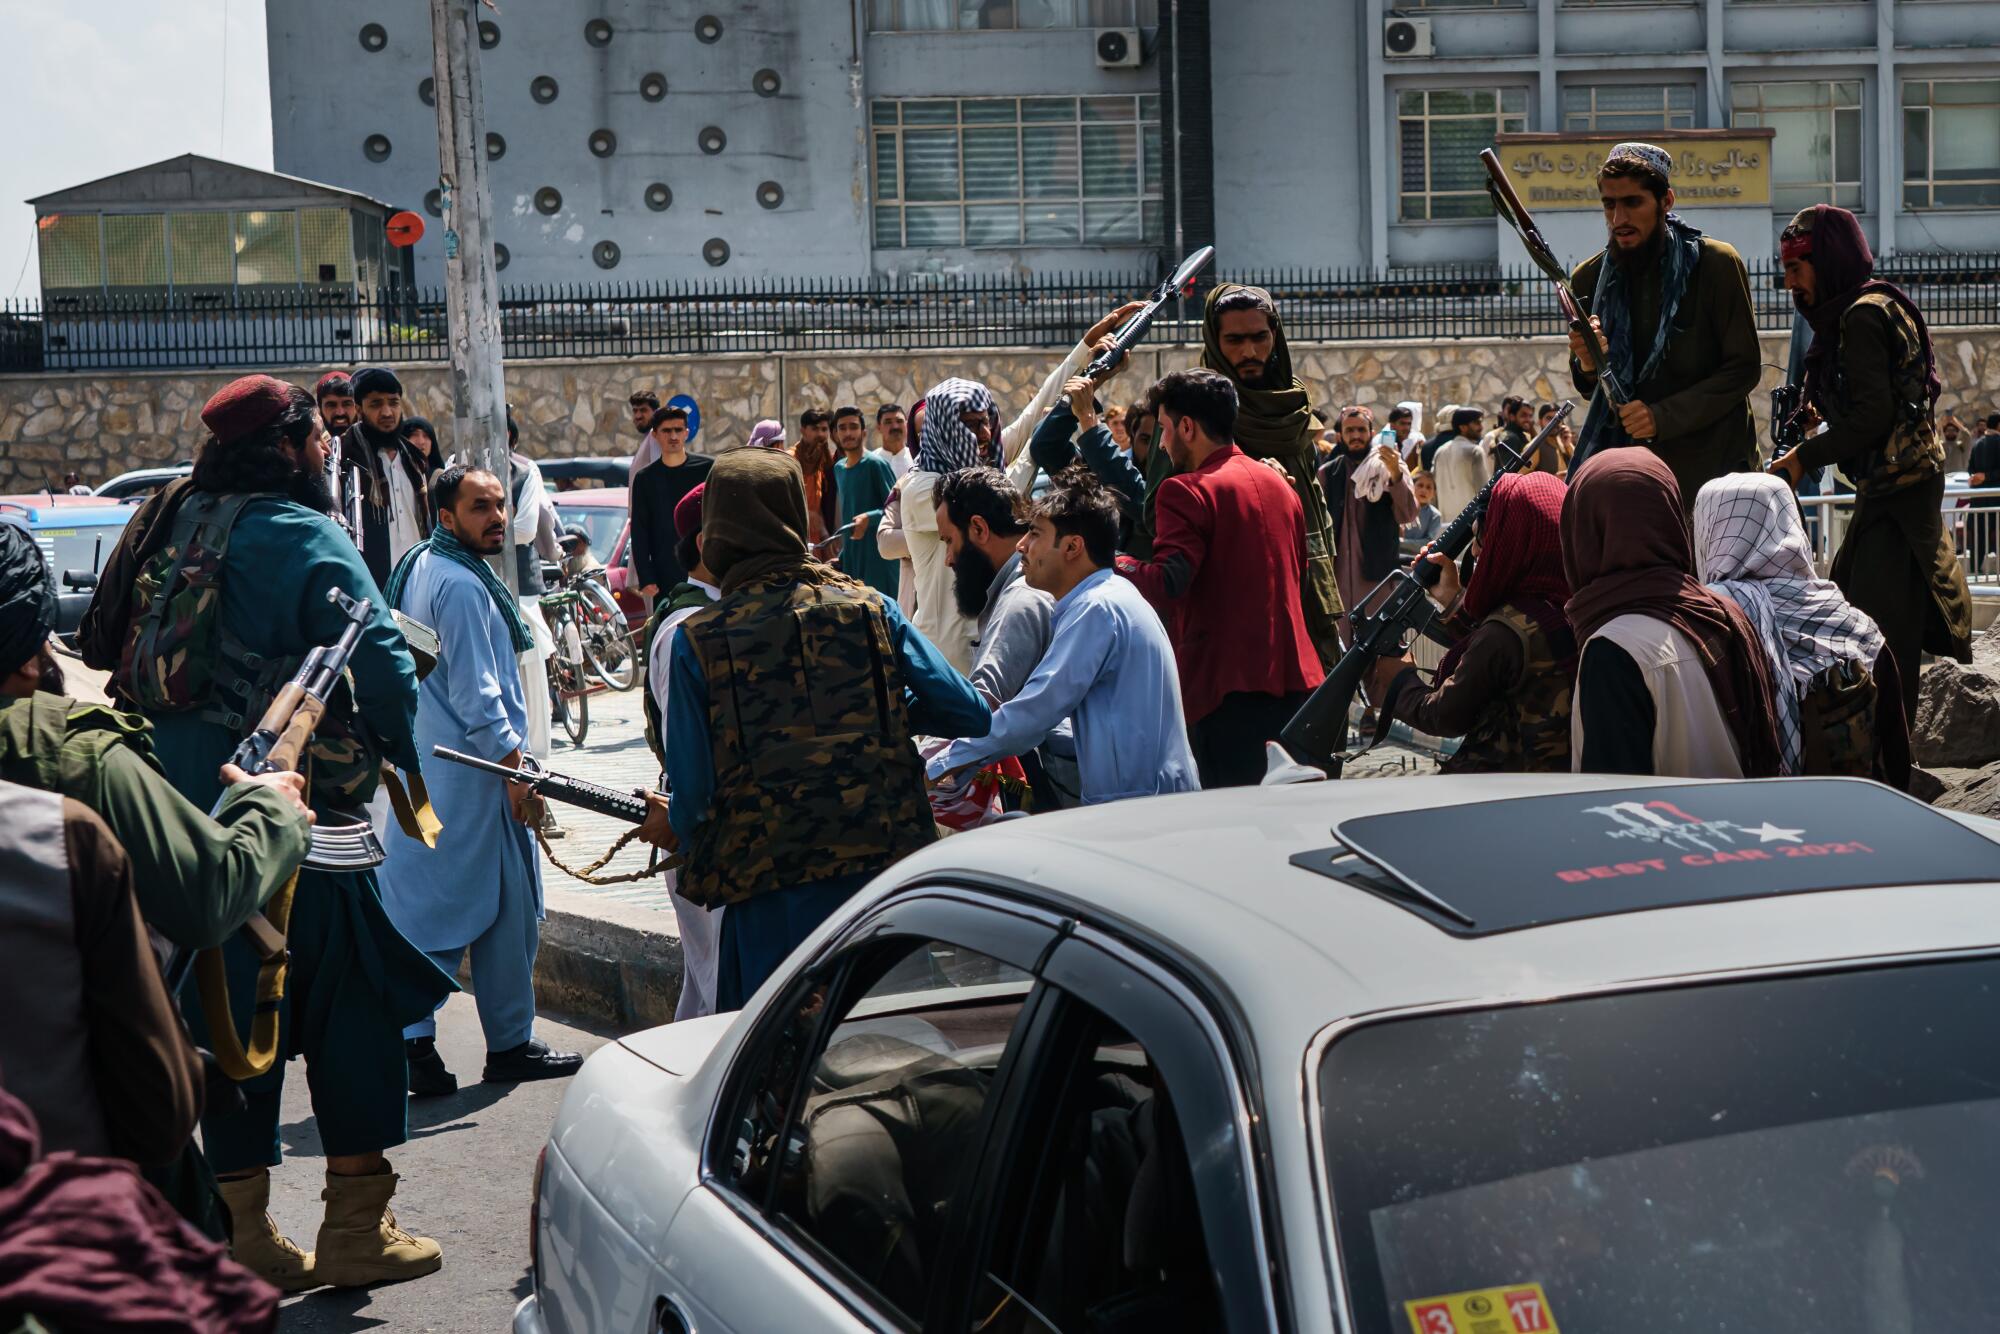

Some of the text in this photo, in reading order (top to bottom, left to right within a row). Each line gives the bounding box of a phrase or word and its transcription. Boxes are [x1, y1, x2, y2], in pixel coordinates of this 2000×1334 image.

[1555, 840, 1876, 884] BEST CAR 2021
[1510, 1298, 1542, 1330] 17
